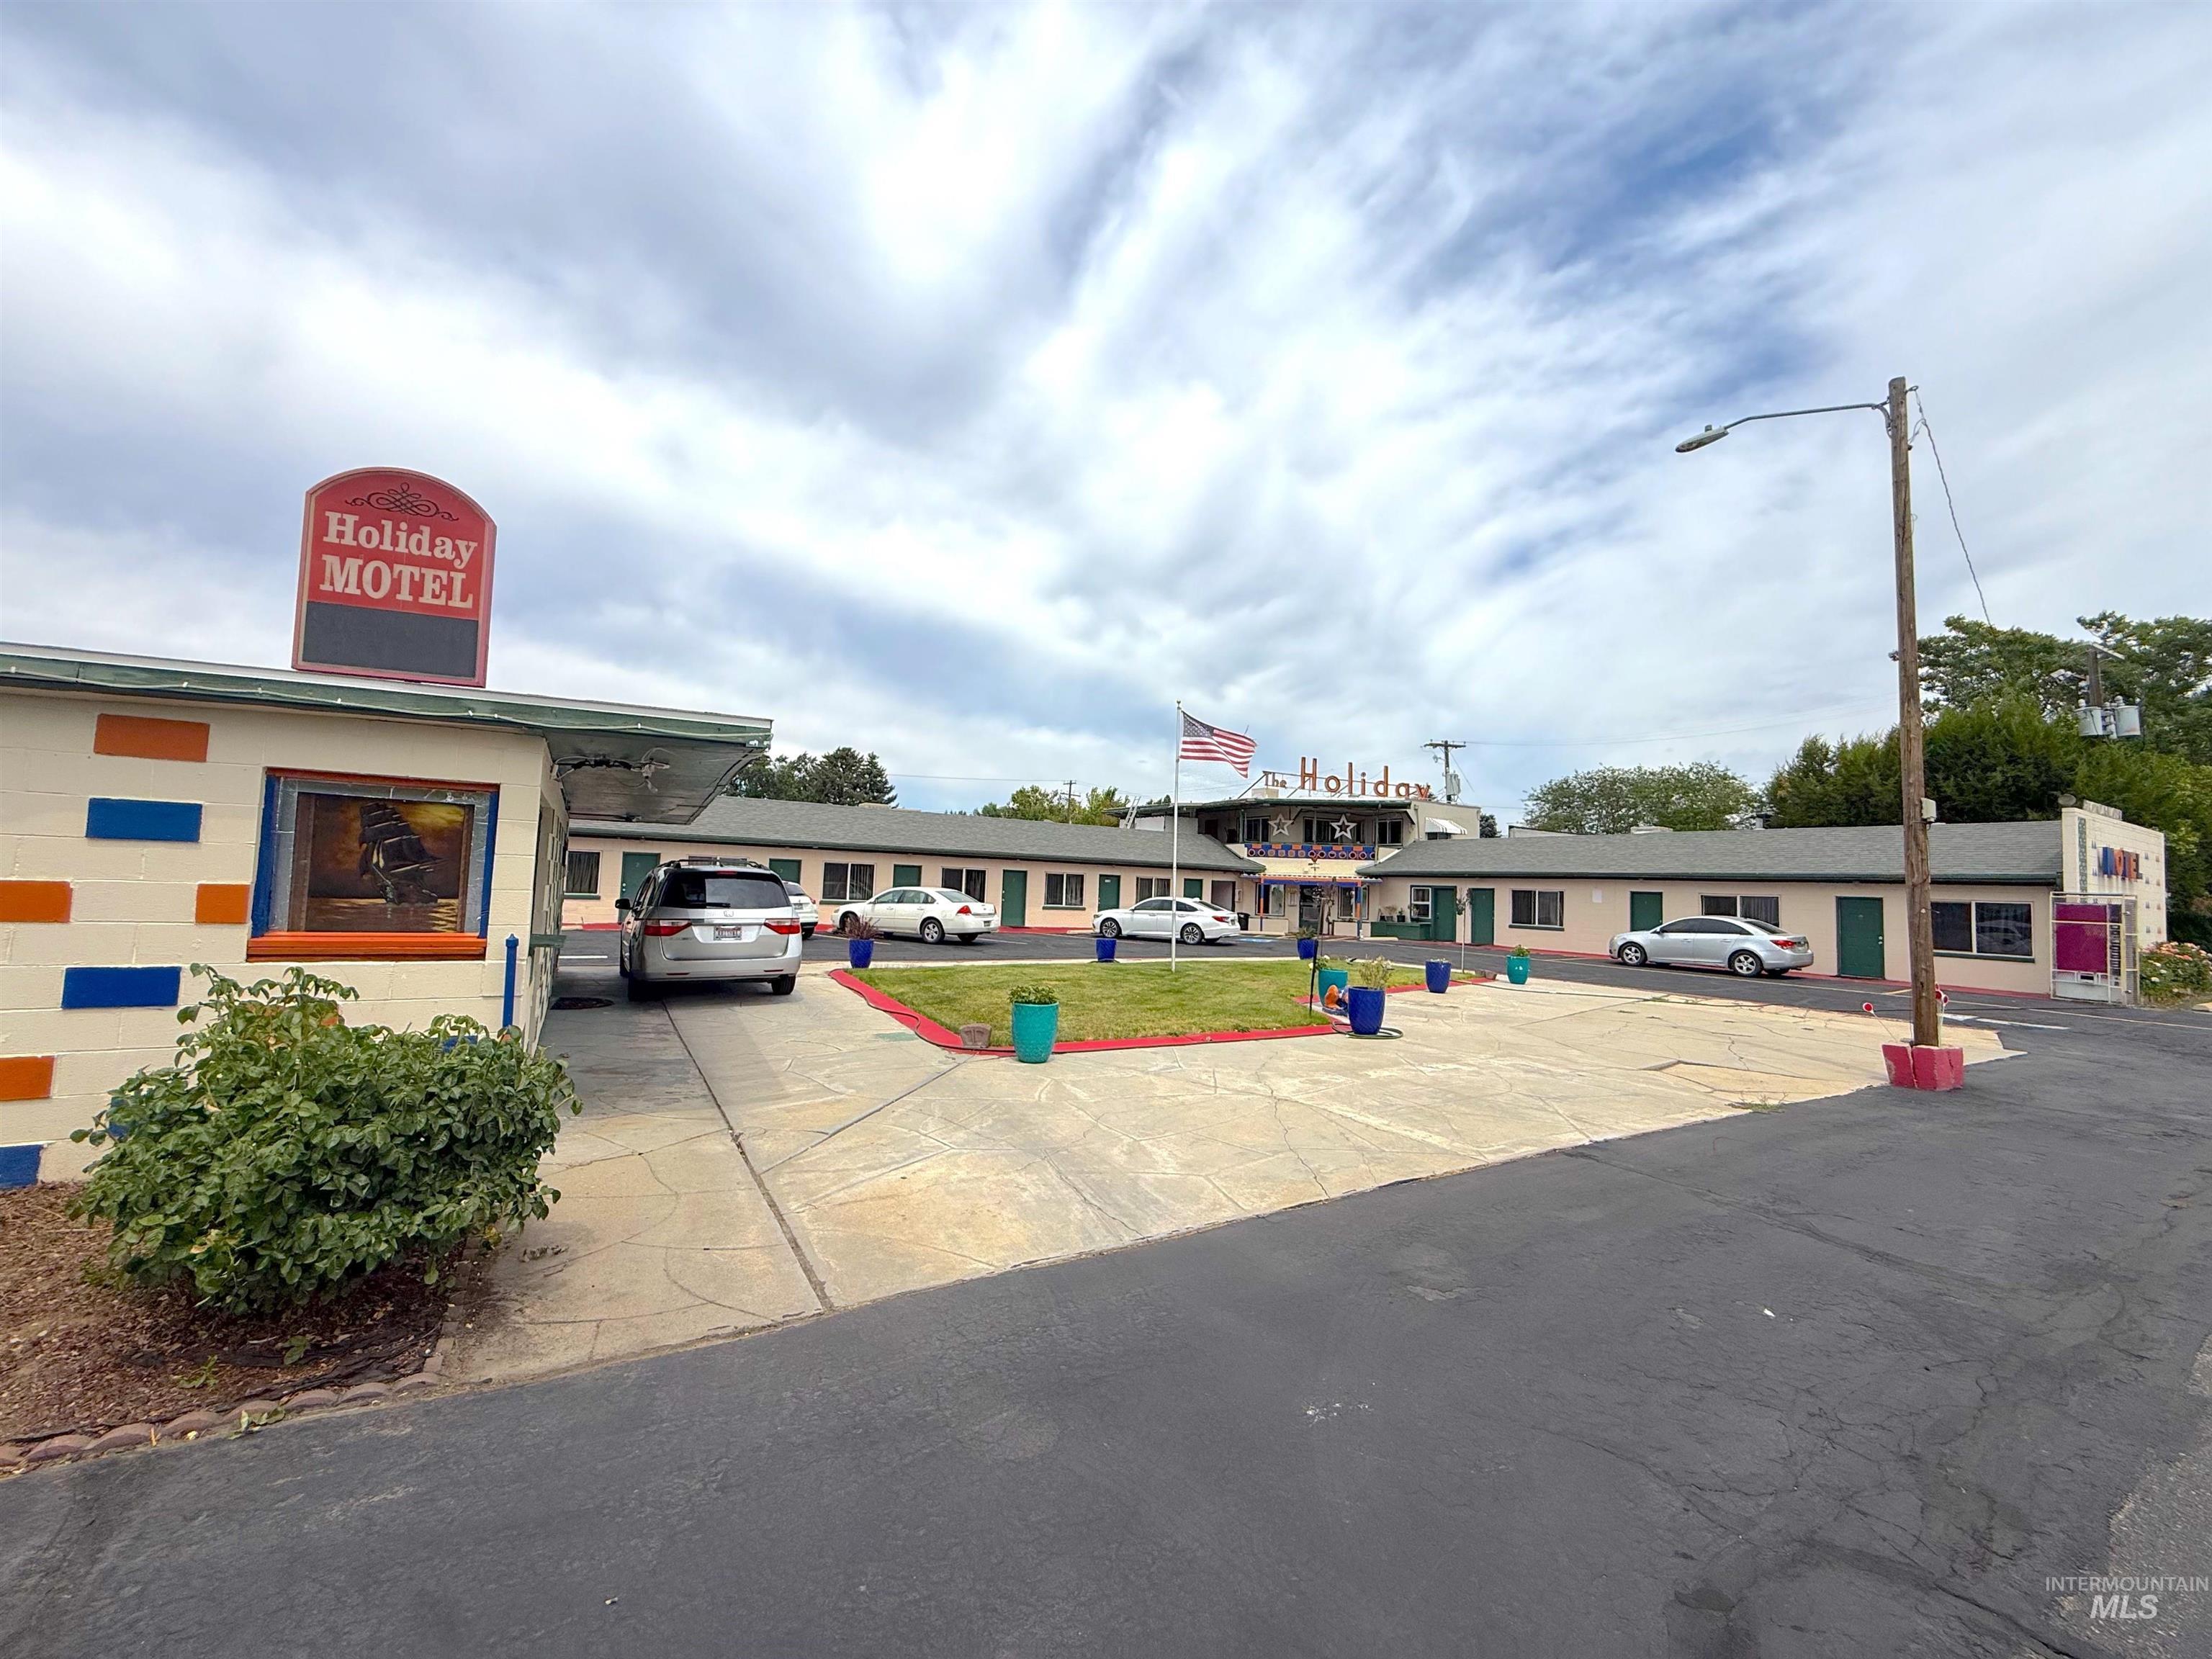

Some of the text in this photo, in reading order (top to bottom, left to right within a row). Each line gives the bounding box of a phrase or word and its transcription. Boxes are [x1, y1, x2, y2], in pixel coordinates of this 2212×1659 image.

[323, 511, 478, 570] Holiday
[319, 554, 473, 608] MOTEL
[1262, 756, 1431, 799] The Holiday
